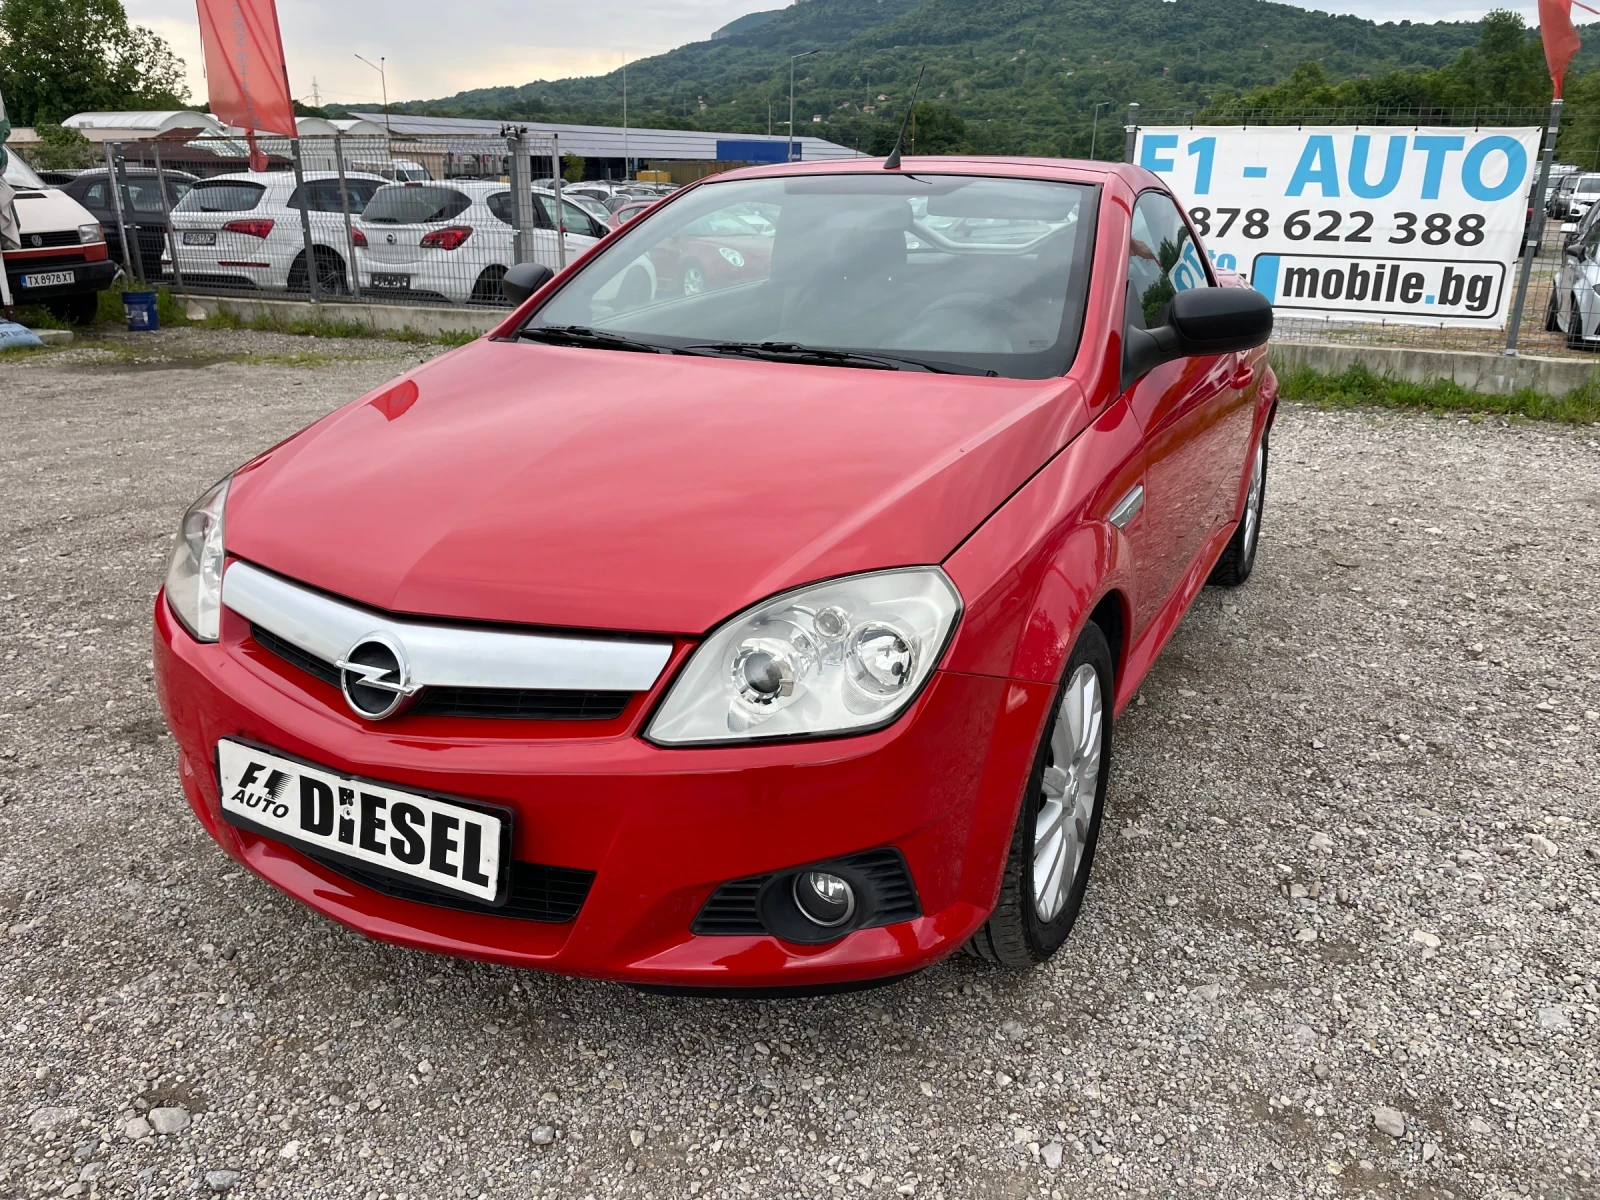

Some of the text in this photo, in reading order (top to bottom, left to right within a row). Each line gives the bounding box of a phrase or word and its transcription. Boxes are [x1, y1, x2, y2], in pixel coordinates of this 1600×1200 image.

[1140, 134, 1217, 195] F1
[1285, 134, 1528, 202] AUTO
[1283, 209, 1374, 243] 622
[1388, 212, 1486, 247] 388
[1283, 264, 1493, 312] mobile.bg
[231, 788, 290, 819] AUTO
[238, 761, 490, 889] F1 DIESEL
